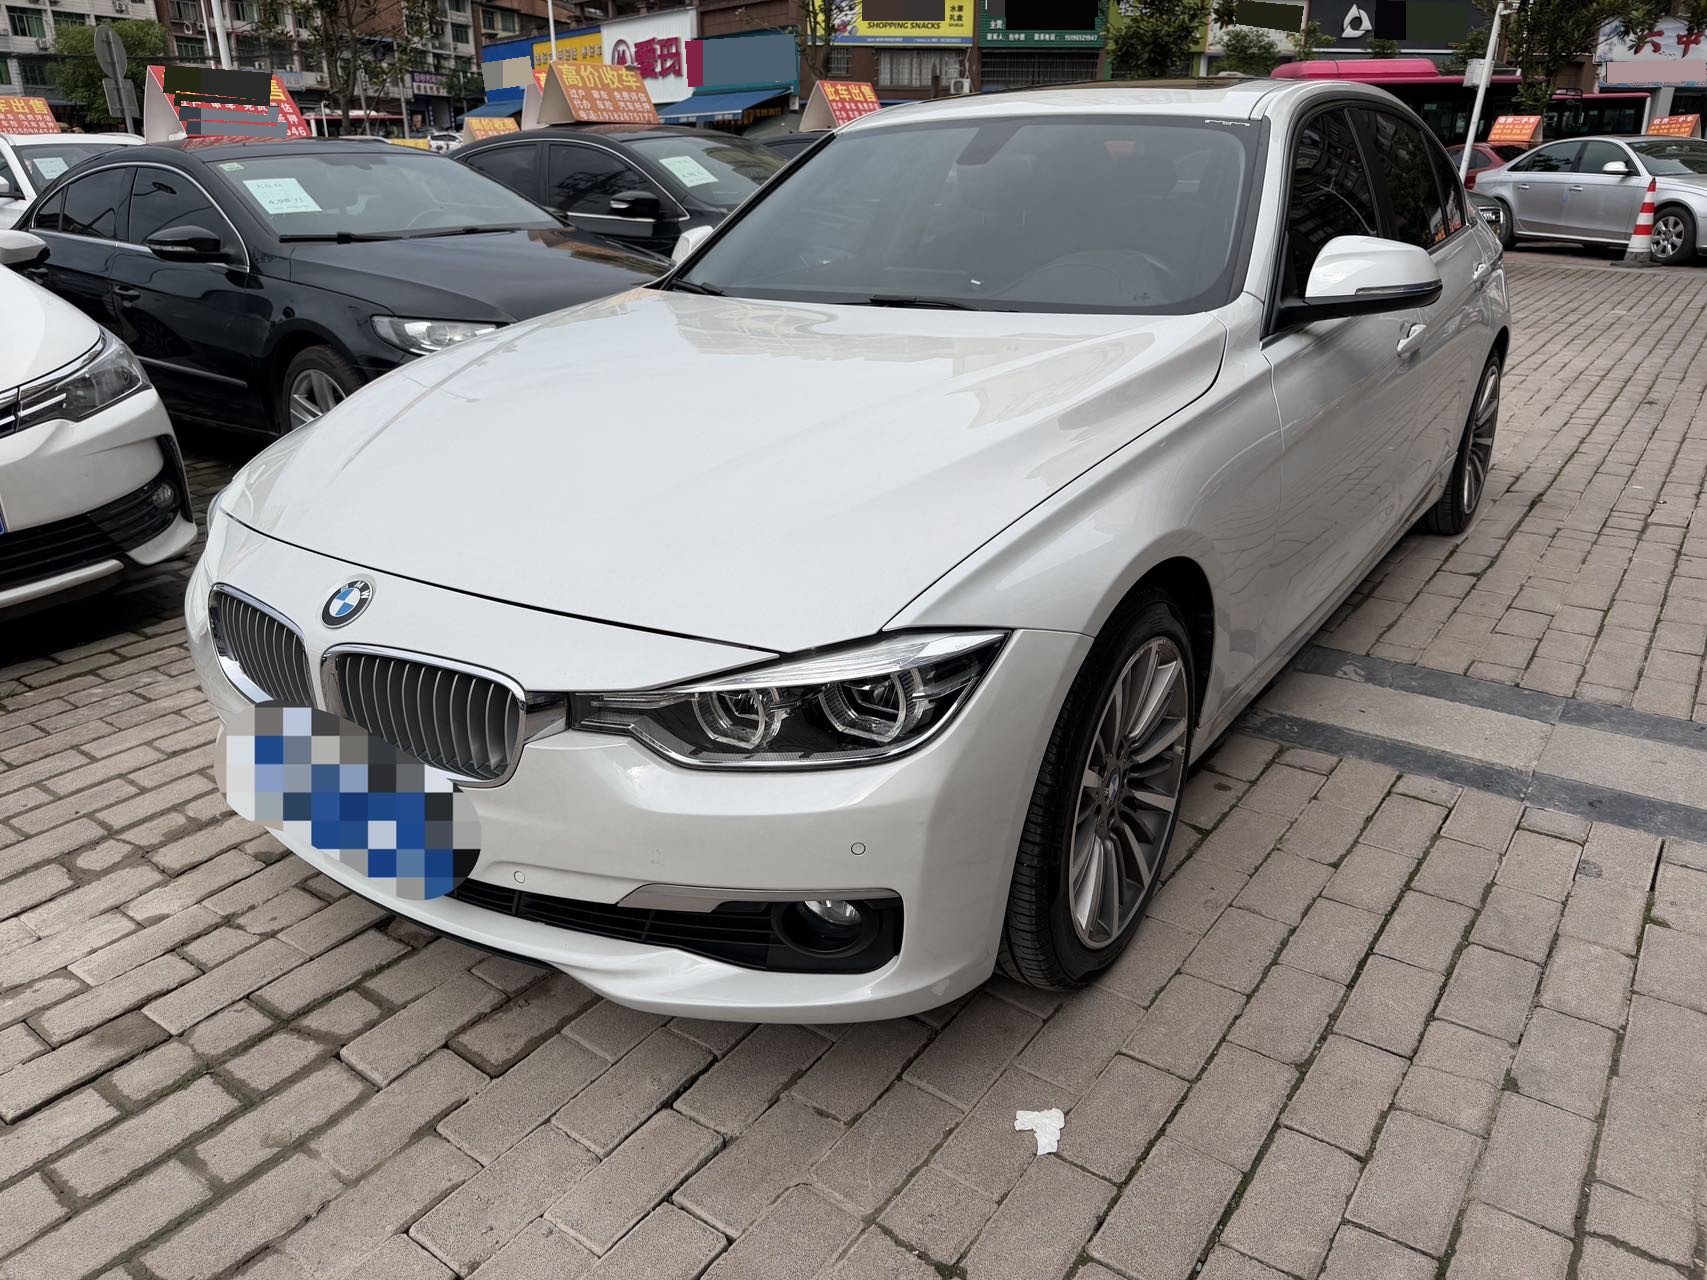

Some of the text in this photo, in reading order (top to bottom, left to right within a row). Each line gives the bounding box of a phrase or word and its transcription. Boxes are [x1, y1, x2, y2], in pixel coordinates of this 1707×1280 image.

[558, 63, 641, 89] 高价收车
[824, 83, 876, 101] 此车出售
